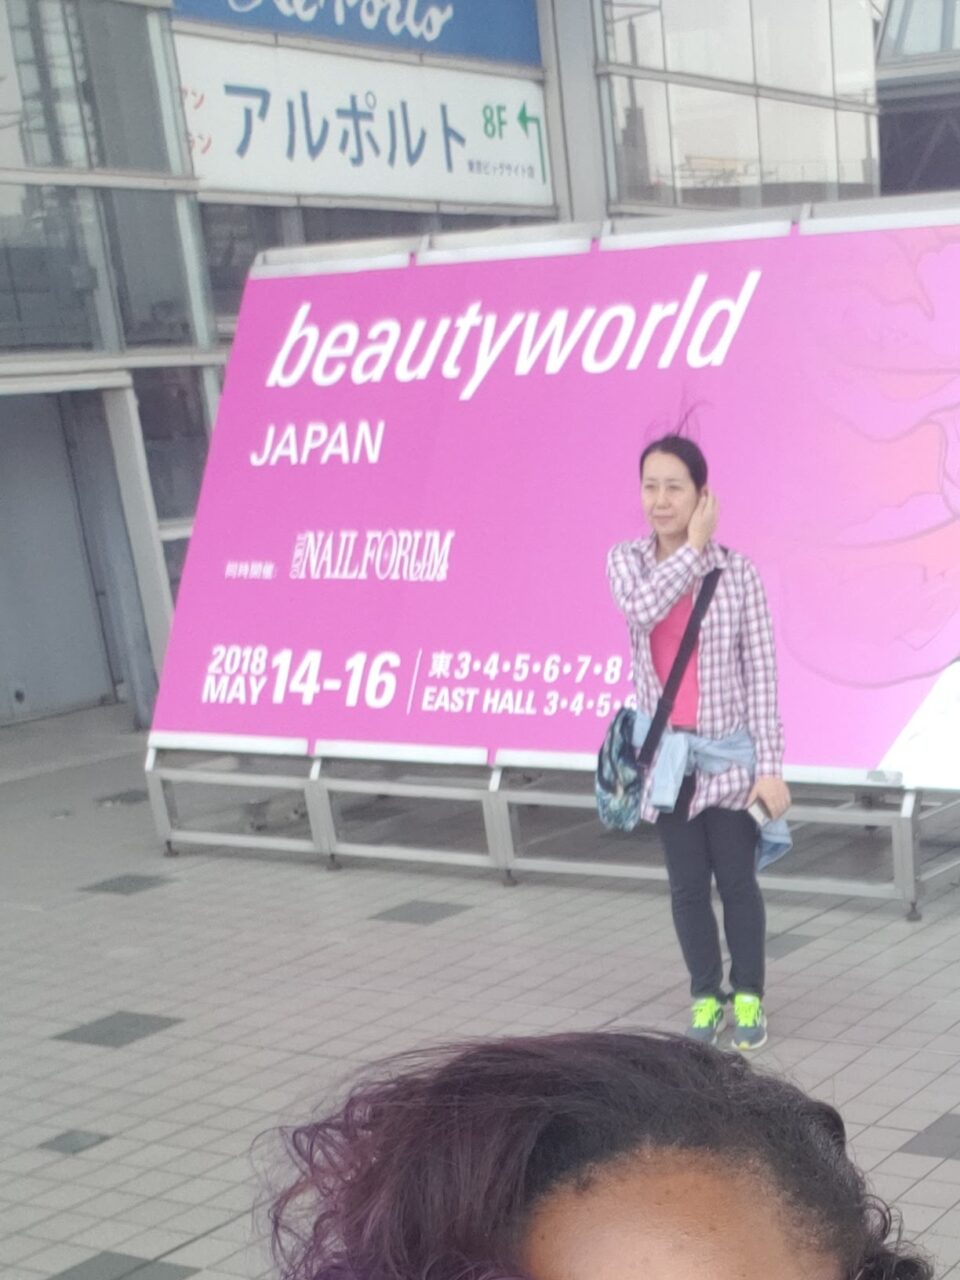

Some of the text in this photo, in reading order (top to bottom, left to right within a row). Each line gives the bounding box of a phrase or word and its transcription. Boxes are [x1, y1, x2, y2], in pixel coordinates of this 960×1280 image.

[223, 84, 466, 174] アルポルト
[482, 104, 507, 139] 8F
[265, 270, 762, 400] beautyworld
[249, 420, 385, 467] JAPAN
[299, 529, 456, 582] NAIL FORUM
[202, 648, 402, 709] MAY 14-16
[207, 644, 268, 675] 2018
[421, 686, 480, 714] EAST
[482, 687, 537, 716] HALL
